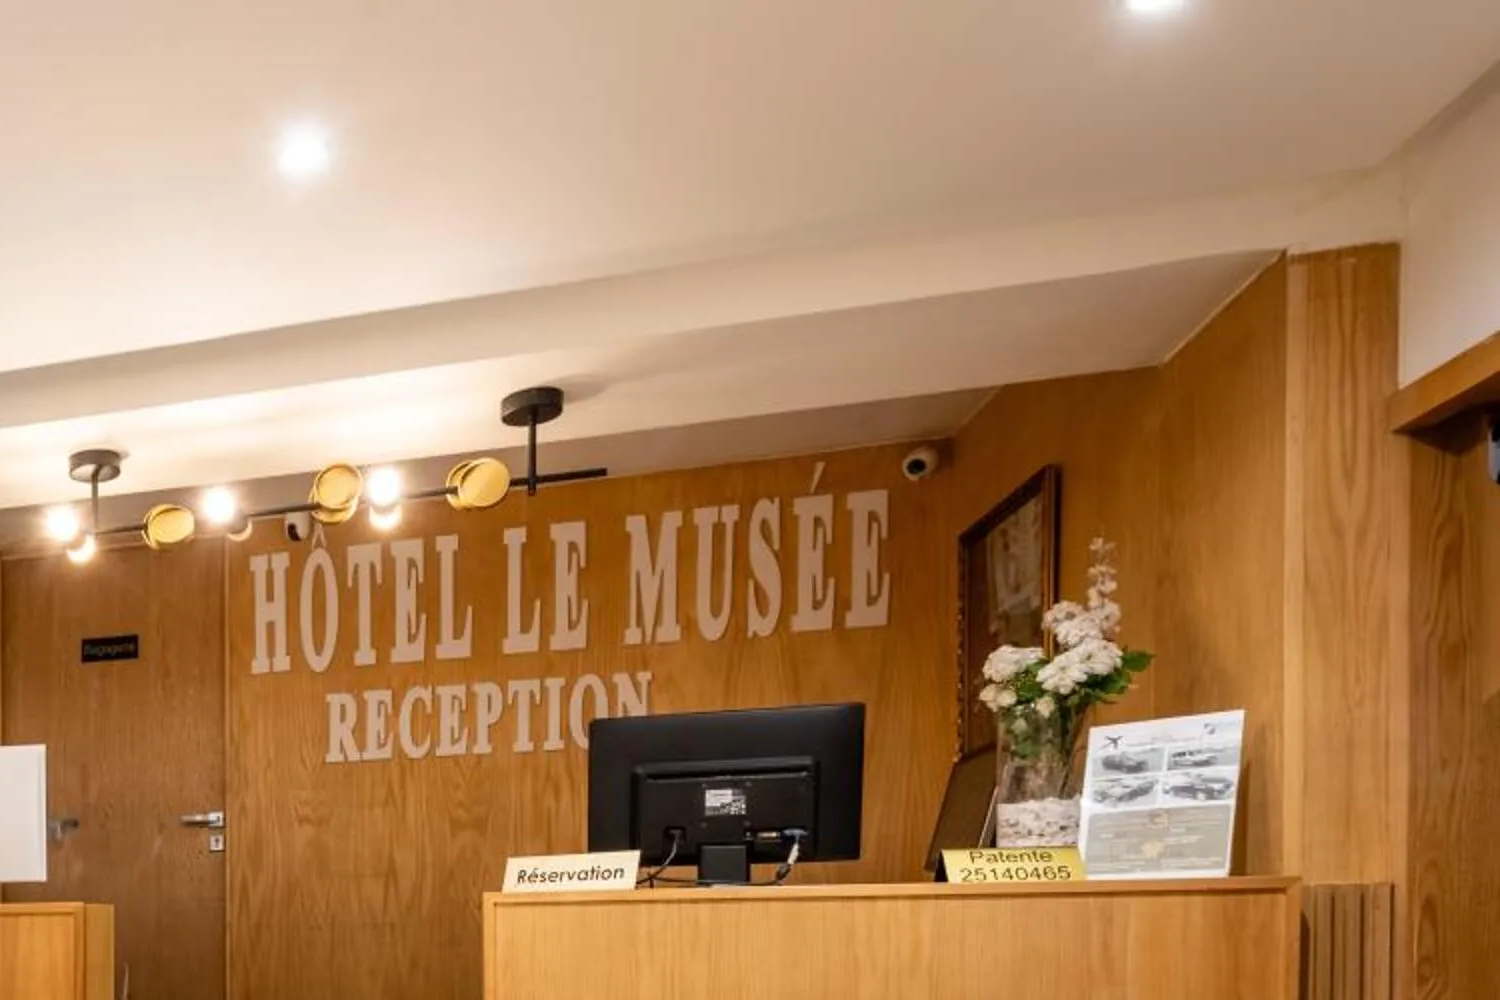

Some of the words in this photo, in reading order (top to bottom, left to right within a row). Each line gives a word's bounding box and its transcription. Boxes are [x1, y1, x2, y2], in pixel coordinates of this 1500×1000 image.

[249, 523, 474, 675] HÔTEL
[502, 520, 589, 655] LE
[623, 461, 890, 647] MUSÉE
[968, 849, 1054, 865] Patente
[516, 865, 625, 884] Réservation
[959, 864, 1072, 882] 25140465
